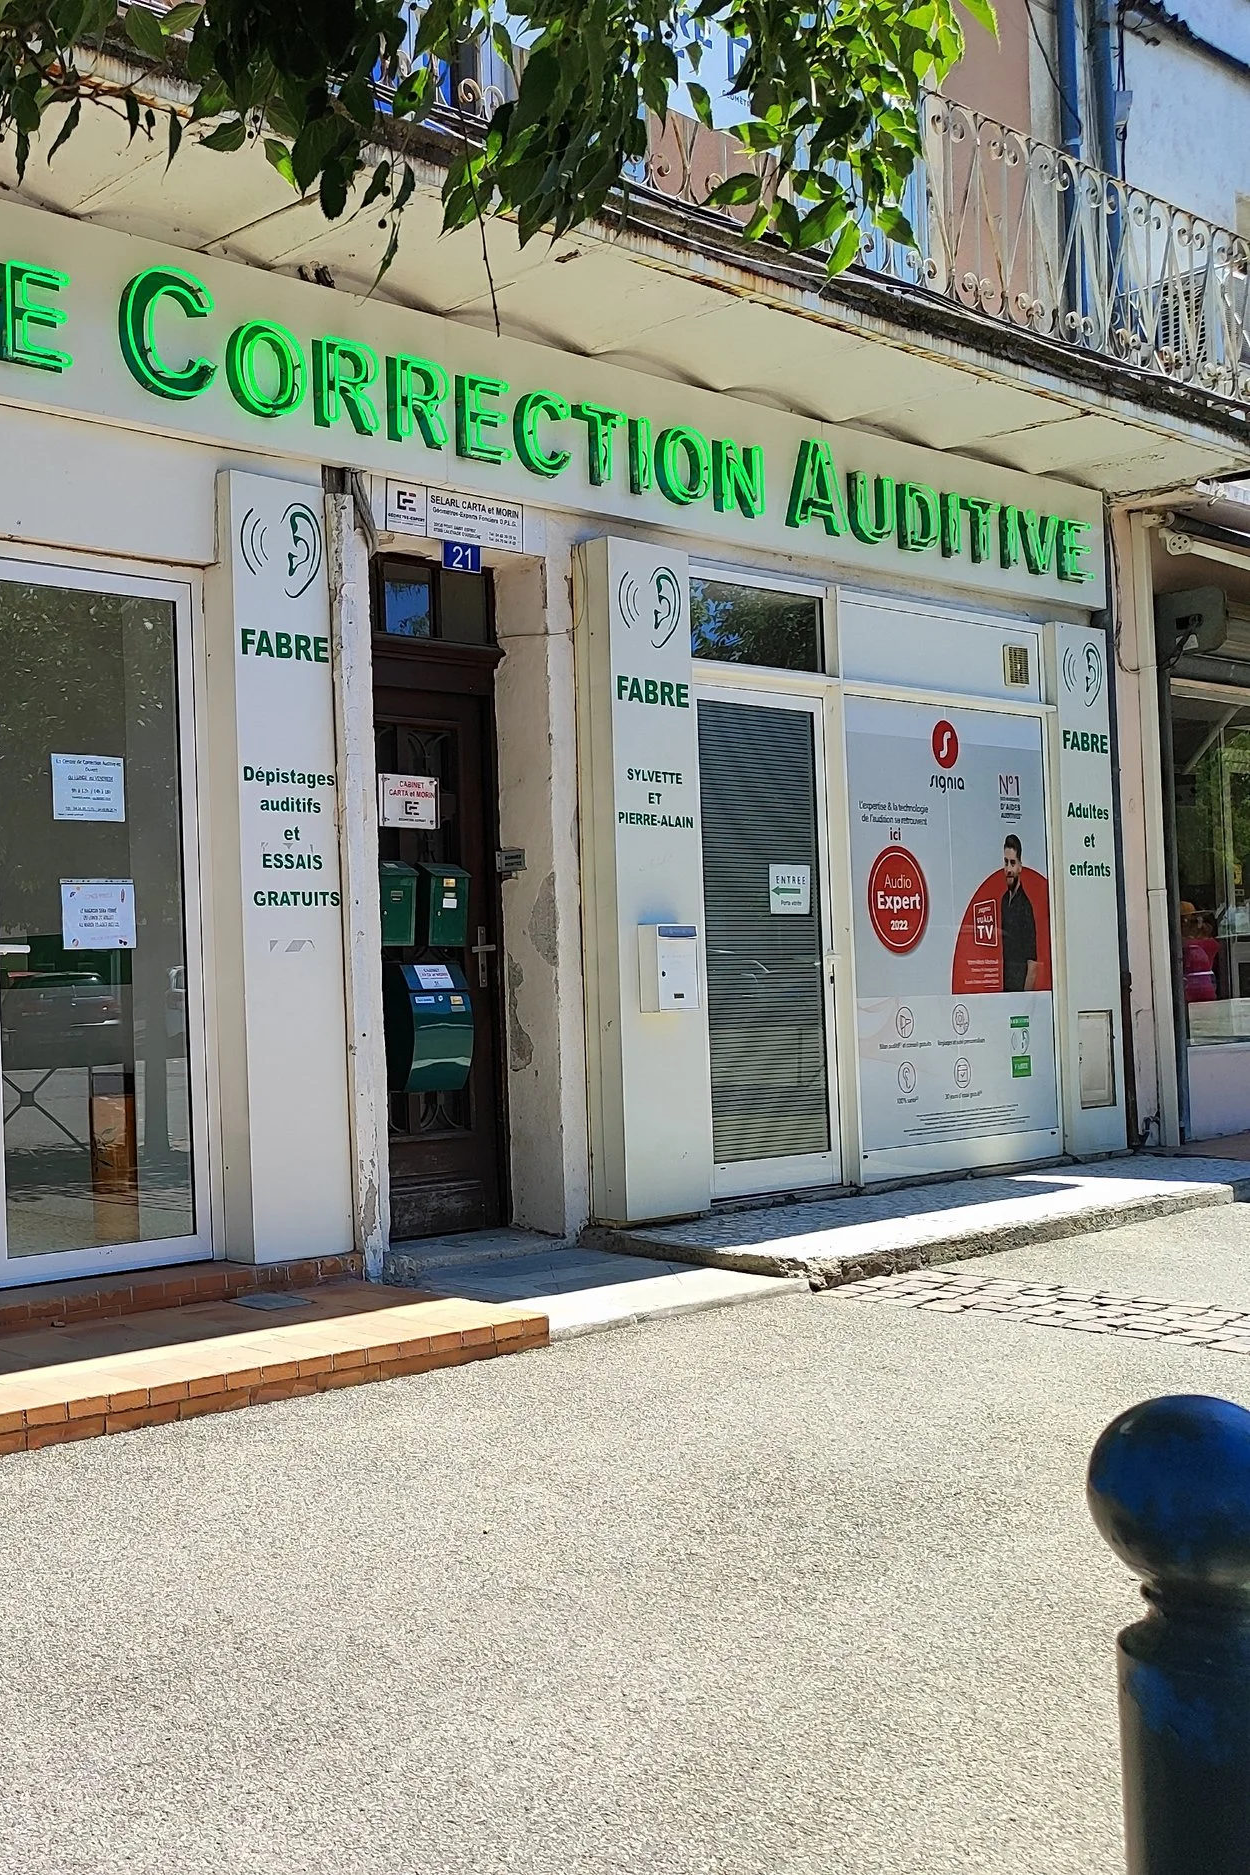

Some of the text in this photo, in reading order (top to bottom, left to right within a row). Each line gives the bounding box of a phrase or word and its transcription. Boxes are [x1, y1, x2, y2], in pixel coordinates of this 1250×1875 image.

[119, 265, 766, 518] CORRECTION
[784, 438, 1096, 583] AUDITIVE
[431, 494, 520, 519] SELARL CARTA et MORIN
[452, 546, 472, 570] 21
[241, 628, 329, 663] FABRE
[617, 675, 689, 708] FABRE
[1063, 729, 1108, 754] FABRE
[243, 766, 336, 789] Dépistages
[400, 780, 424, 789] CABINET
[627, 768, 683, 785] SYLVETTE
[929, 774, 966, 794] signia
[389, 788, 408, 797] CARTA
[416, 790, 435, 799] MORIN
[648, 792, 662, 805] ET
[260, 797, 322, 814] auditifs
[1067, 802, 1109, 820] Adultes
[618, 812, 694, 829] PIERRE-ALAIN
[283, 826, 300, 842] et
[890, 827, 901, 840] ici
[1084, 833, 1095, 848] et
[262, 853, 323, 870] ESSAIS
[1070, 861, 1111, 877] enfants
[776, 875, 806, 885] ENTREE
[884, 874, 912, 889] Audio
[253, 891, 341, 907] GRATUITS
[877, 891, 921, 914] Expert
[890, 920, 909, 931] 2022
[977, 925, 994, 940] TV
